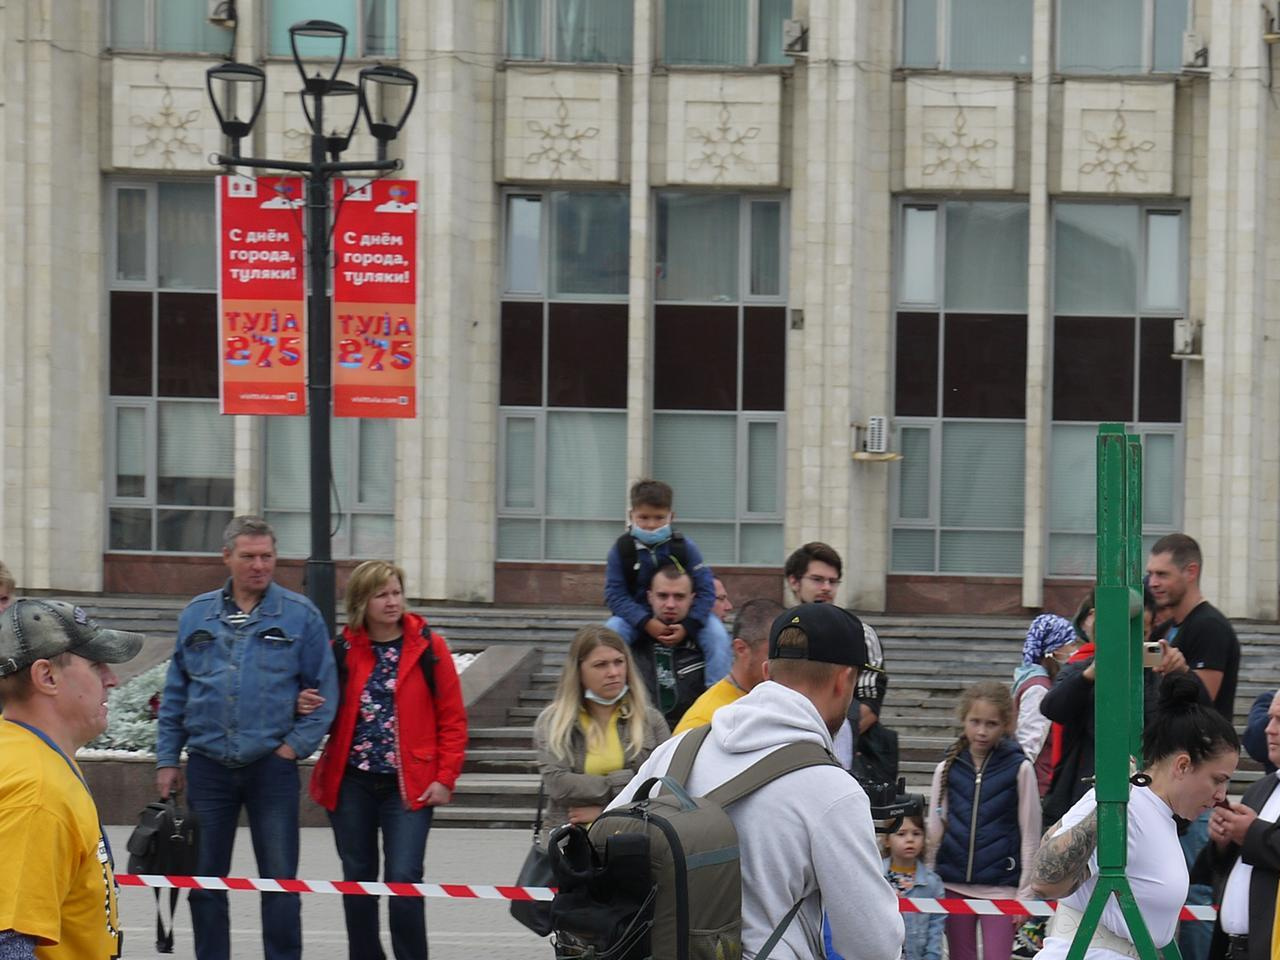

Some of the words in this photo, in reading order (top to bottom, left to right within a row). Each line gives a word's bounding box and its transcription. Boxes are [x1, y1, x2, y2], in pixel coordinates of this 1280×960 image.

[229, 229, 241, 242] С
[245, 228, 290, 244] днём
[344, 231, 356, 244] С
[360, 230, 403, 247] днём
[229, 249, 295, 263] города,
[344, 252, 409, 267] города,
[229, 267, 297, 283] туляки!
[344, 271, 410, 286] туляки!
[224, 334, 301, 368] 875
[338, 337, 413, 371] 875
